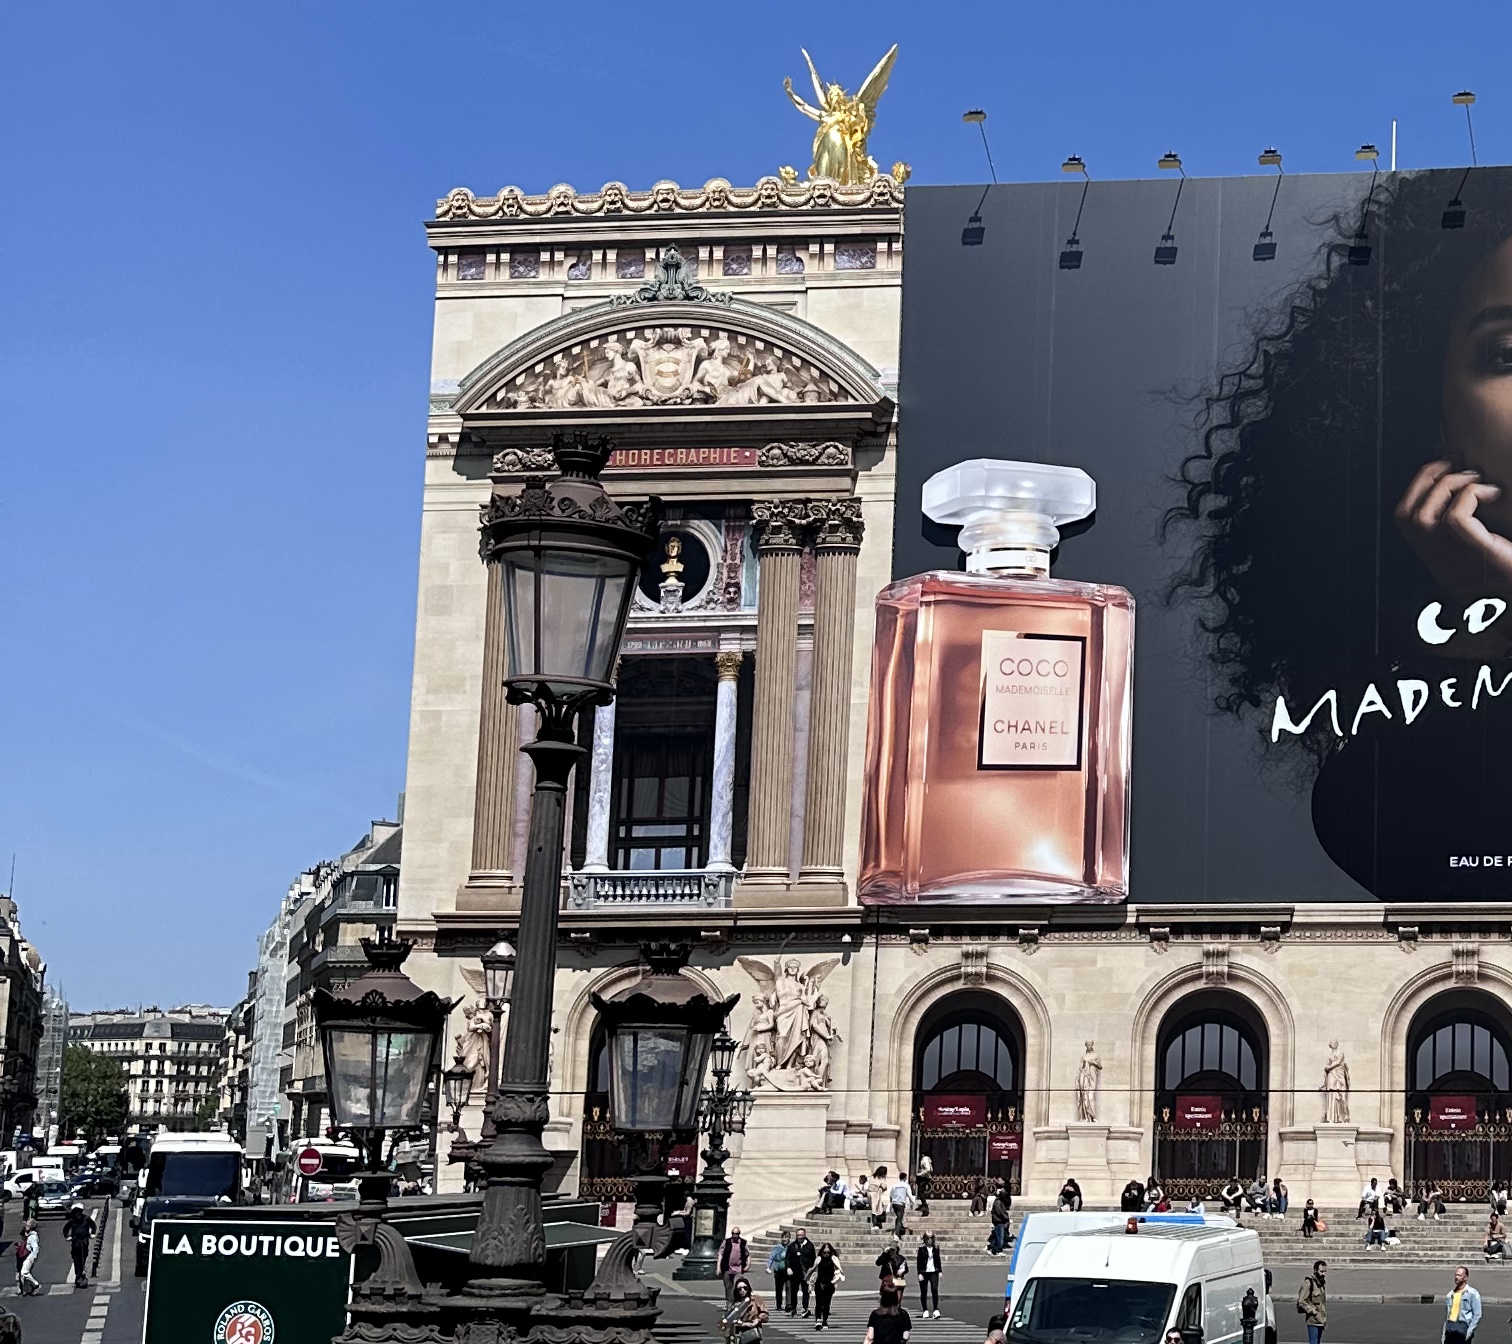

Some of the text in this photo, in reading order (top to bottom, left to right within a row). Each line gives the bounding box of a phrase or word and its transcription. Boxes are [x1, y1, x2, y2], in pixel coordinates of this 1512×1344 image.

[606, 447, 740, 466] HOREGRAPHIE
[999, 657, 1069, 678] COCO
[995, 684, 1071, 696] MADEMOISELLE
[993, 719, 1070, 735] CHANEL
[1014, 741, 1048, 751] PARIS
[1449, 856, 1479, 867] EAU
[1483, 856, 1503, 867] DE
[162, 1234, 340, 1258] LA BOUTIQUE
[217, 1304, 272, 1342] ROLAND GARROS
